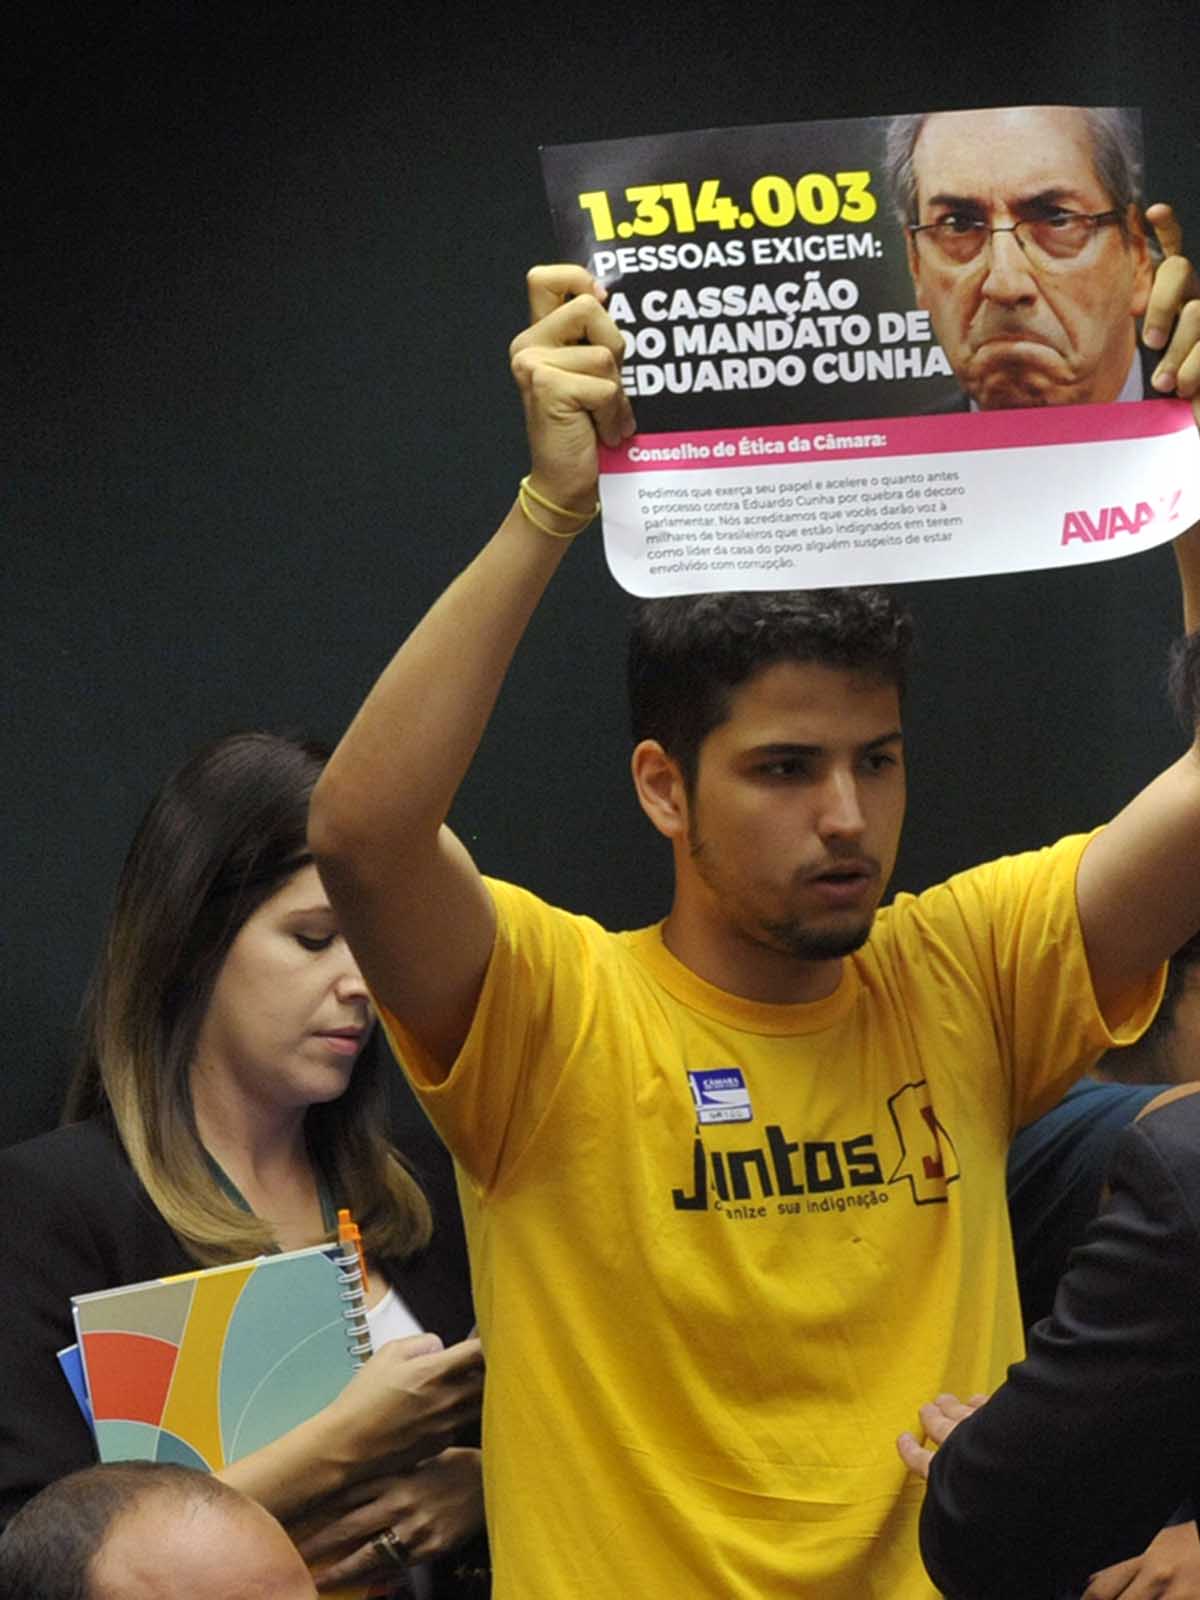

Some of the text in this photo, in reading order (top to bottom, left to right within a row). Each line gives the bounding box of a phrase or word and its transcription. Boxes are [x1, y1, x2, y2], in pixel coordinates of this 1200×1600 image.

[578, 171, 878, 242] 1.314.003
[593, 232, 885, 278] PESSOAS EXIGEM:
[608, 271, 860, 324] A CASSAÇÃO
[674, 318, 872, 358] MANDATO
[878, 310, 932, 344] DE
[812, 345, 954, 385] CUNHA
[628, 434, 887, 462] Conselho de Ética da Câmara:
[638, 487, 689, 499] Pedimos
[691, 488, 712, 498] que
[715, 485, 752, 497] exerça
[755, 483, 775, 493] seu
[778, 480, 812, 496] papel
[825, 477, 867, 489] acelere
[881, 474, 925, 486] quanto
[927, 471, 960, 482] antes
[652, 501, 701, 514] processo
[703, 500, 740, 511] contra
[742, 496, 793, 510] Eduardo
[795, 494, 835, 507] Cunha
[838, 494, 858, 506] por
[860, 490, 903, 503] quebra
[906, 487, 921, 498] de
[923, 485, 966, 498] decoro
[719, 514, 741, 525] Nós
[743, 511, 817, 525] acreditamos
[819, 508, 843, 521] que
[845, 507, 878, 518] vocês
[880, 503, 914, 516] darão
[917, 503, 936, 513] voz
[645, 516, 963, 544] milhares de brasileiros que estão indignados em terem
[647, 547, 684, 560] como
[713, 545, 728, 555] da
[730, 545, 754, 554] casa
[757, 543, 771, 554] do
[774, 542, 803, 555] povo
[806, 538, 850, 553] alguém
[853, 535, 902, 548] suspeito
[905, 533, 920, 544] de
[923, 531, 952, 543] estar
[649, 559, 708, 575] envolvido
[710, 560, 735, 570] com
